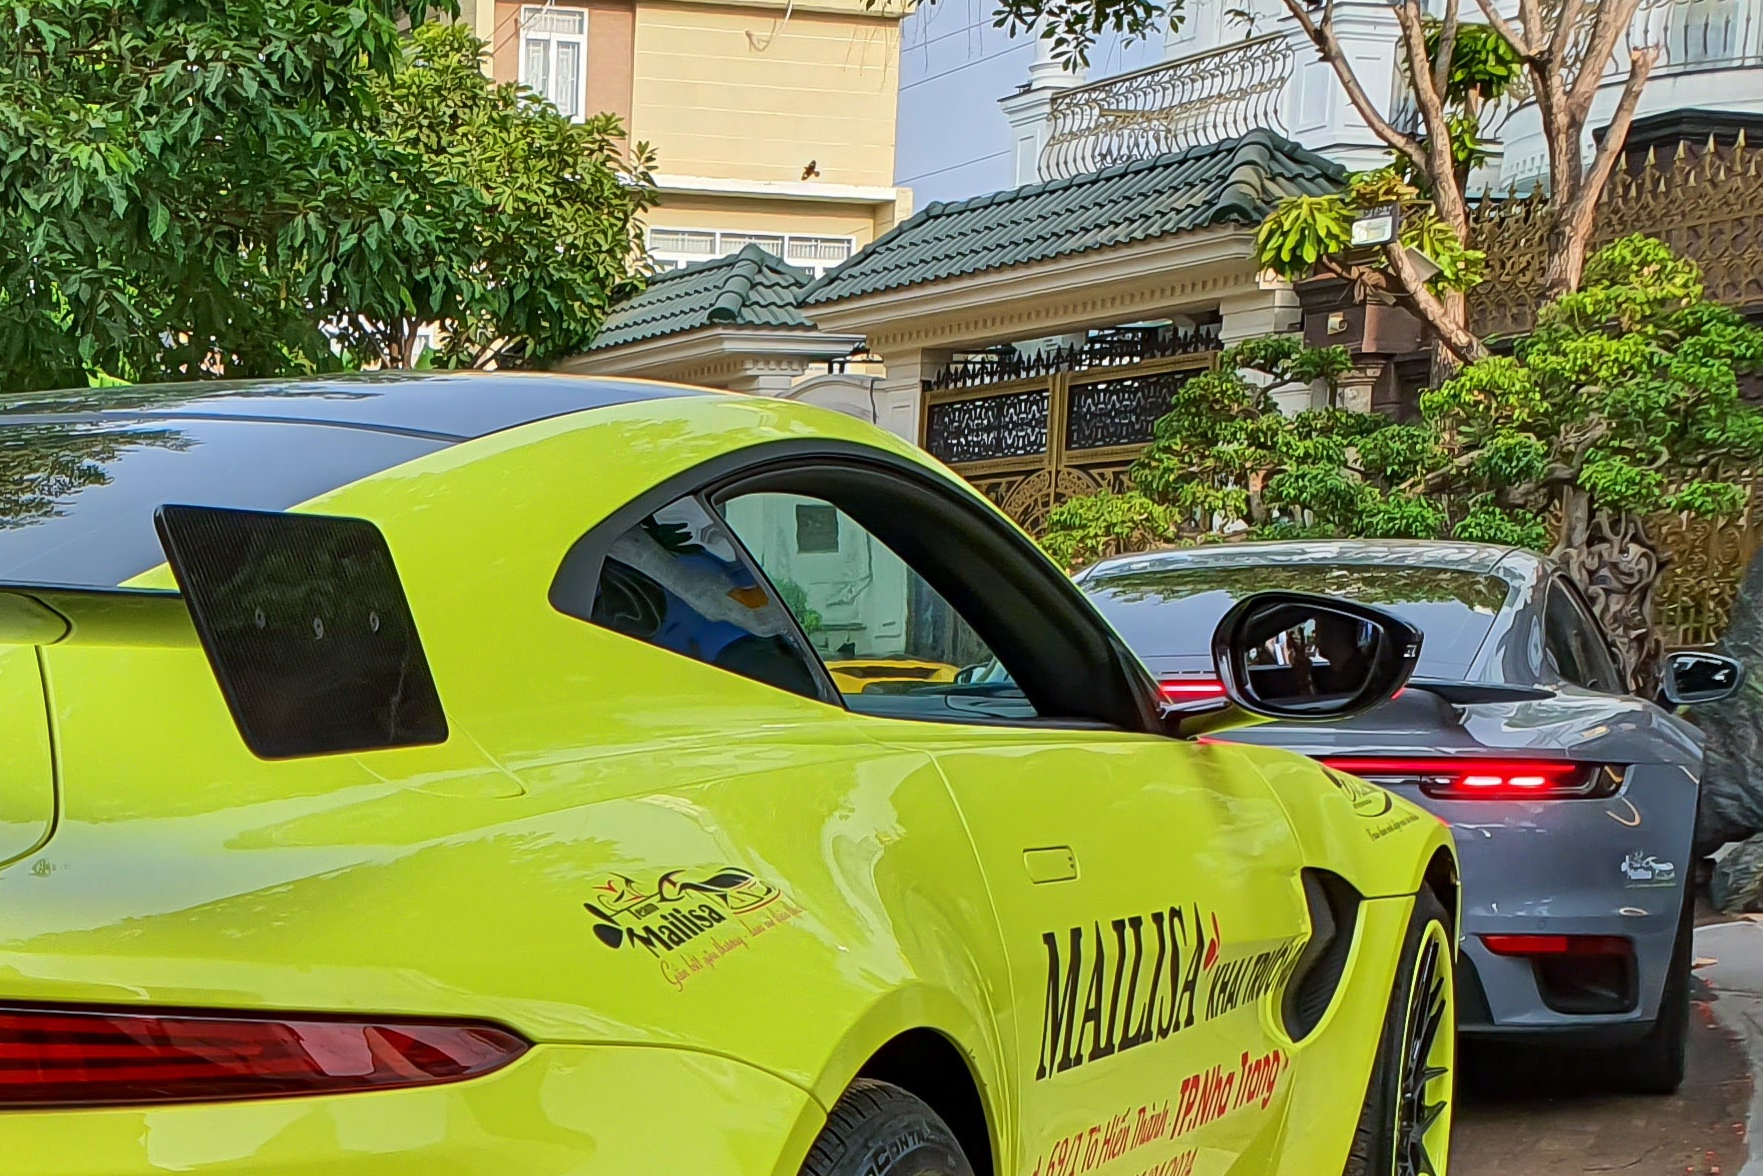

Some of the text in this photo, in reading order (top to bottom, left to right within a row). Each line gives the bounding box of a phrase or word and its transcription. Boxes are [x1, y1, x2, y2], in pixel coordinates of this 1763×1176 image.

[625, 904, 727, 958] Mailisa
[1035, 902, 1205, 1082] MAILISA
[1205, 955, 1254, 1022] KHAI
[1232, 1050, 1280, 1111] Trang
